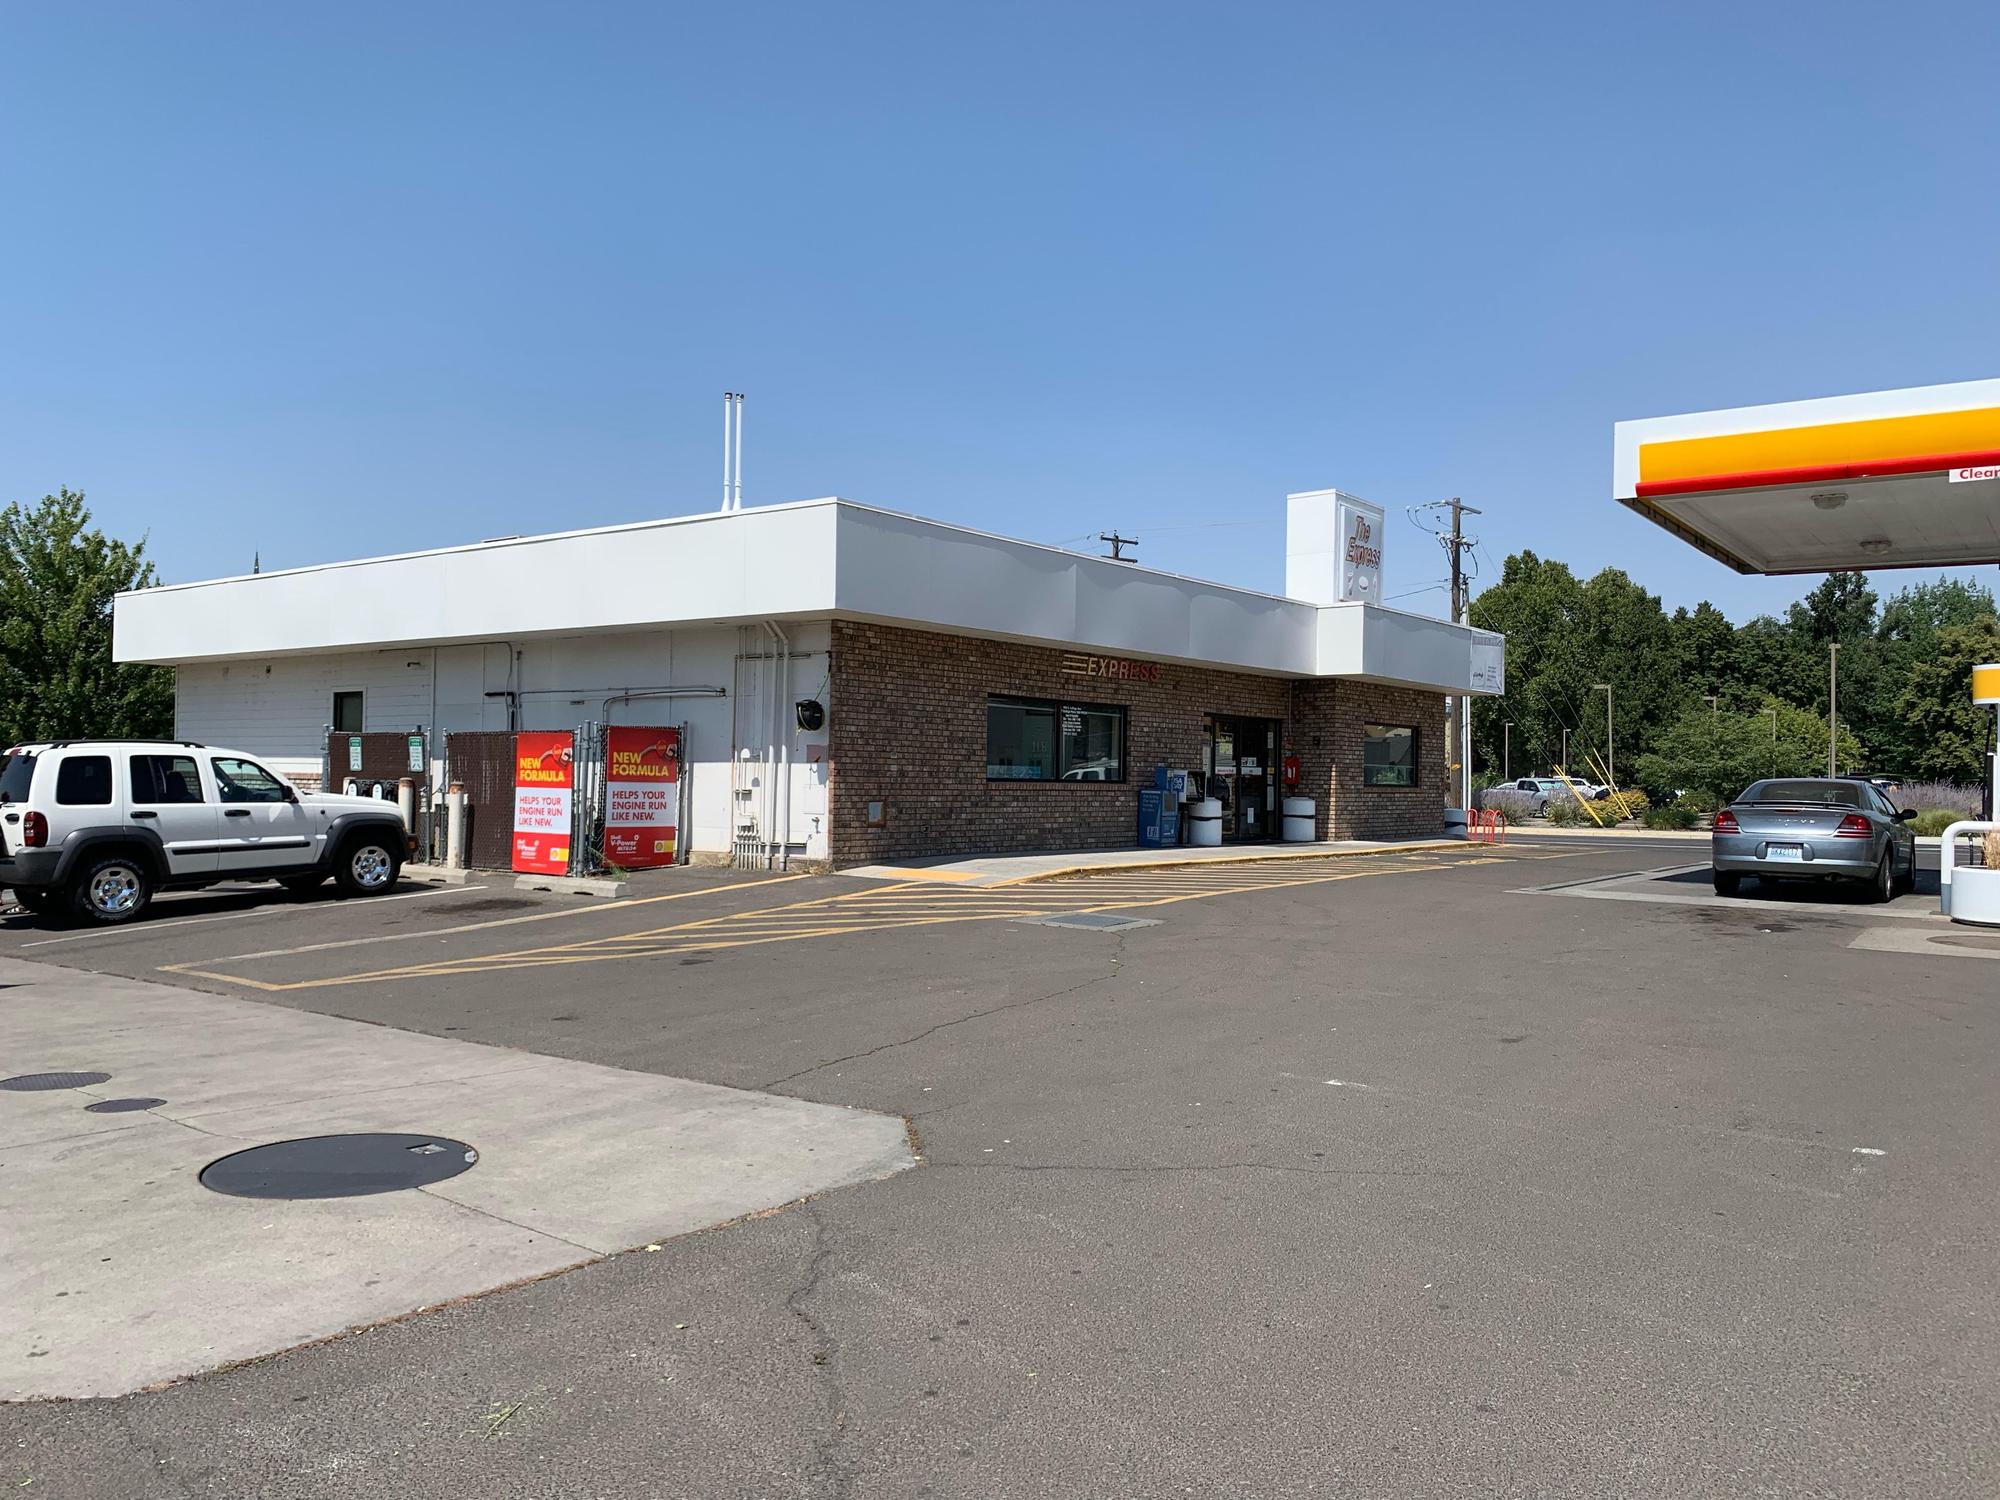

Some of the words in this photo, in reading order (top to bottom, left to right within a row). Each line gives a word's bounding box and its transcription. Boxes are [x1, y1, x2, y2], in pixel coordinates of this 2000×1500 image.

[1355, 515, 1371, 543] The
[1345, 536, 1381, 570] Express
[1087, 657, 1161, 680] EXPRESS
[520, 757, 541, 770] NEW
[613, 751, 641, 764] NEW
[520, 769, 565, 782] FORMULA
[613, 764, 669, 776] FORMULA
[519, 796, 540, 805] HELPS
[541, 796, 561, 806] YOUR
[612, 791, 639, 799] HELPS
[641, 791, 665, 800] YOUR
[519, 806, 545, 816] ENGINE
[547, 807, 563, 817] RUN
[612, 801, 646, 810] ENGINE
[649, 801, 667, 810] RUN
[519, 817, 533, 826] LIKE
[534, 818, 553, 827] NEW.
[612, 812, 629, 820] LIKE
[632, 812, 655, 821] NEW.
